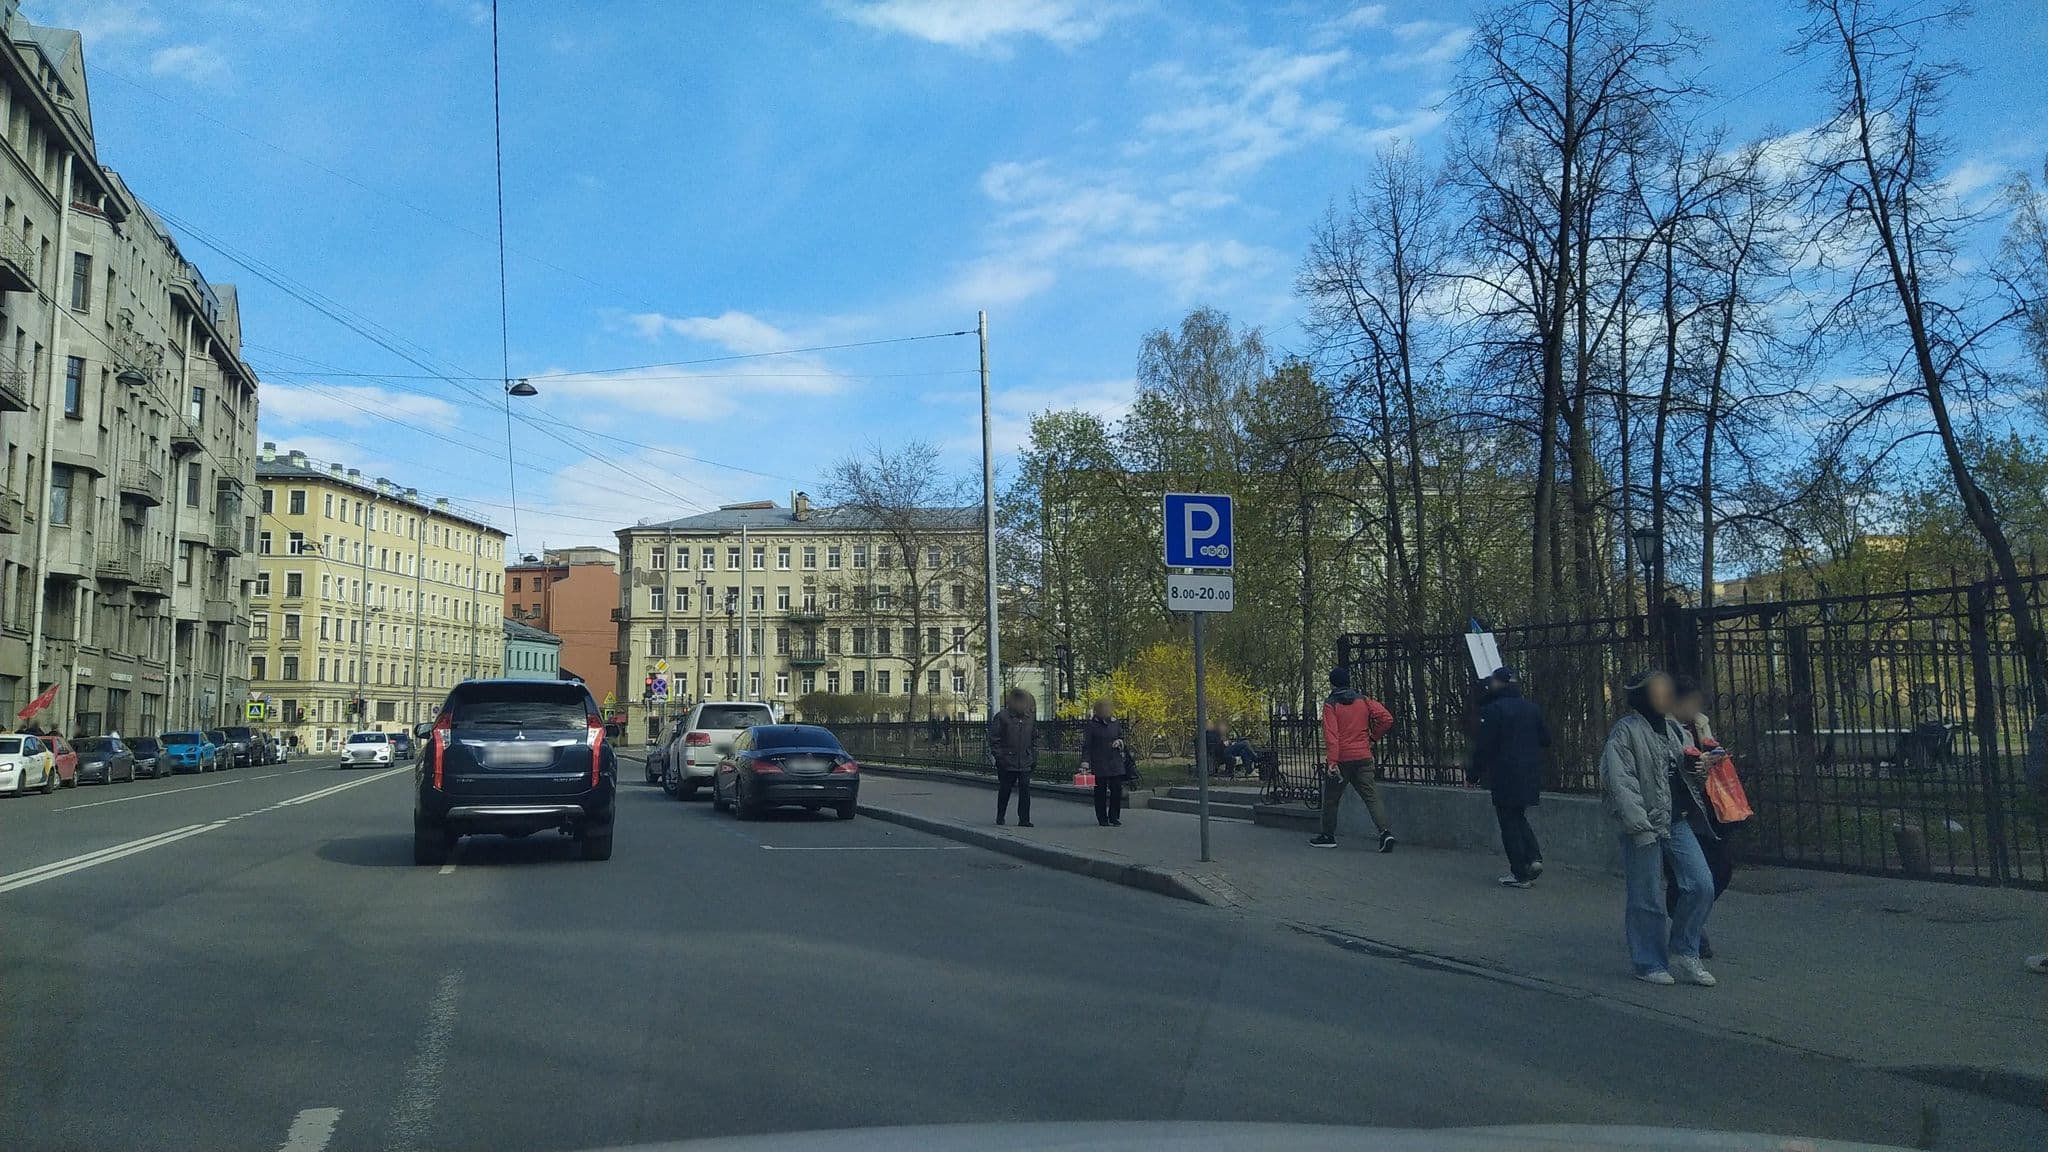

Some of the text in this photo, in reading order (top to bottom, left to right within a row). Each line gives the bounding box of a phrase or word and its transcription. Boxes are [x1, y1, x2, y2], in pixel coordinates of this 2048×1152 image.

[1184, 503, 1220, 558] P
[1218, 547, 1228, 556] 20
[1171, 586, 1230, 600] 8.00-20.00
